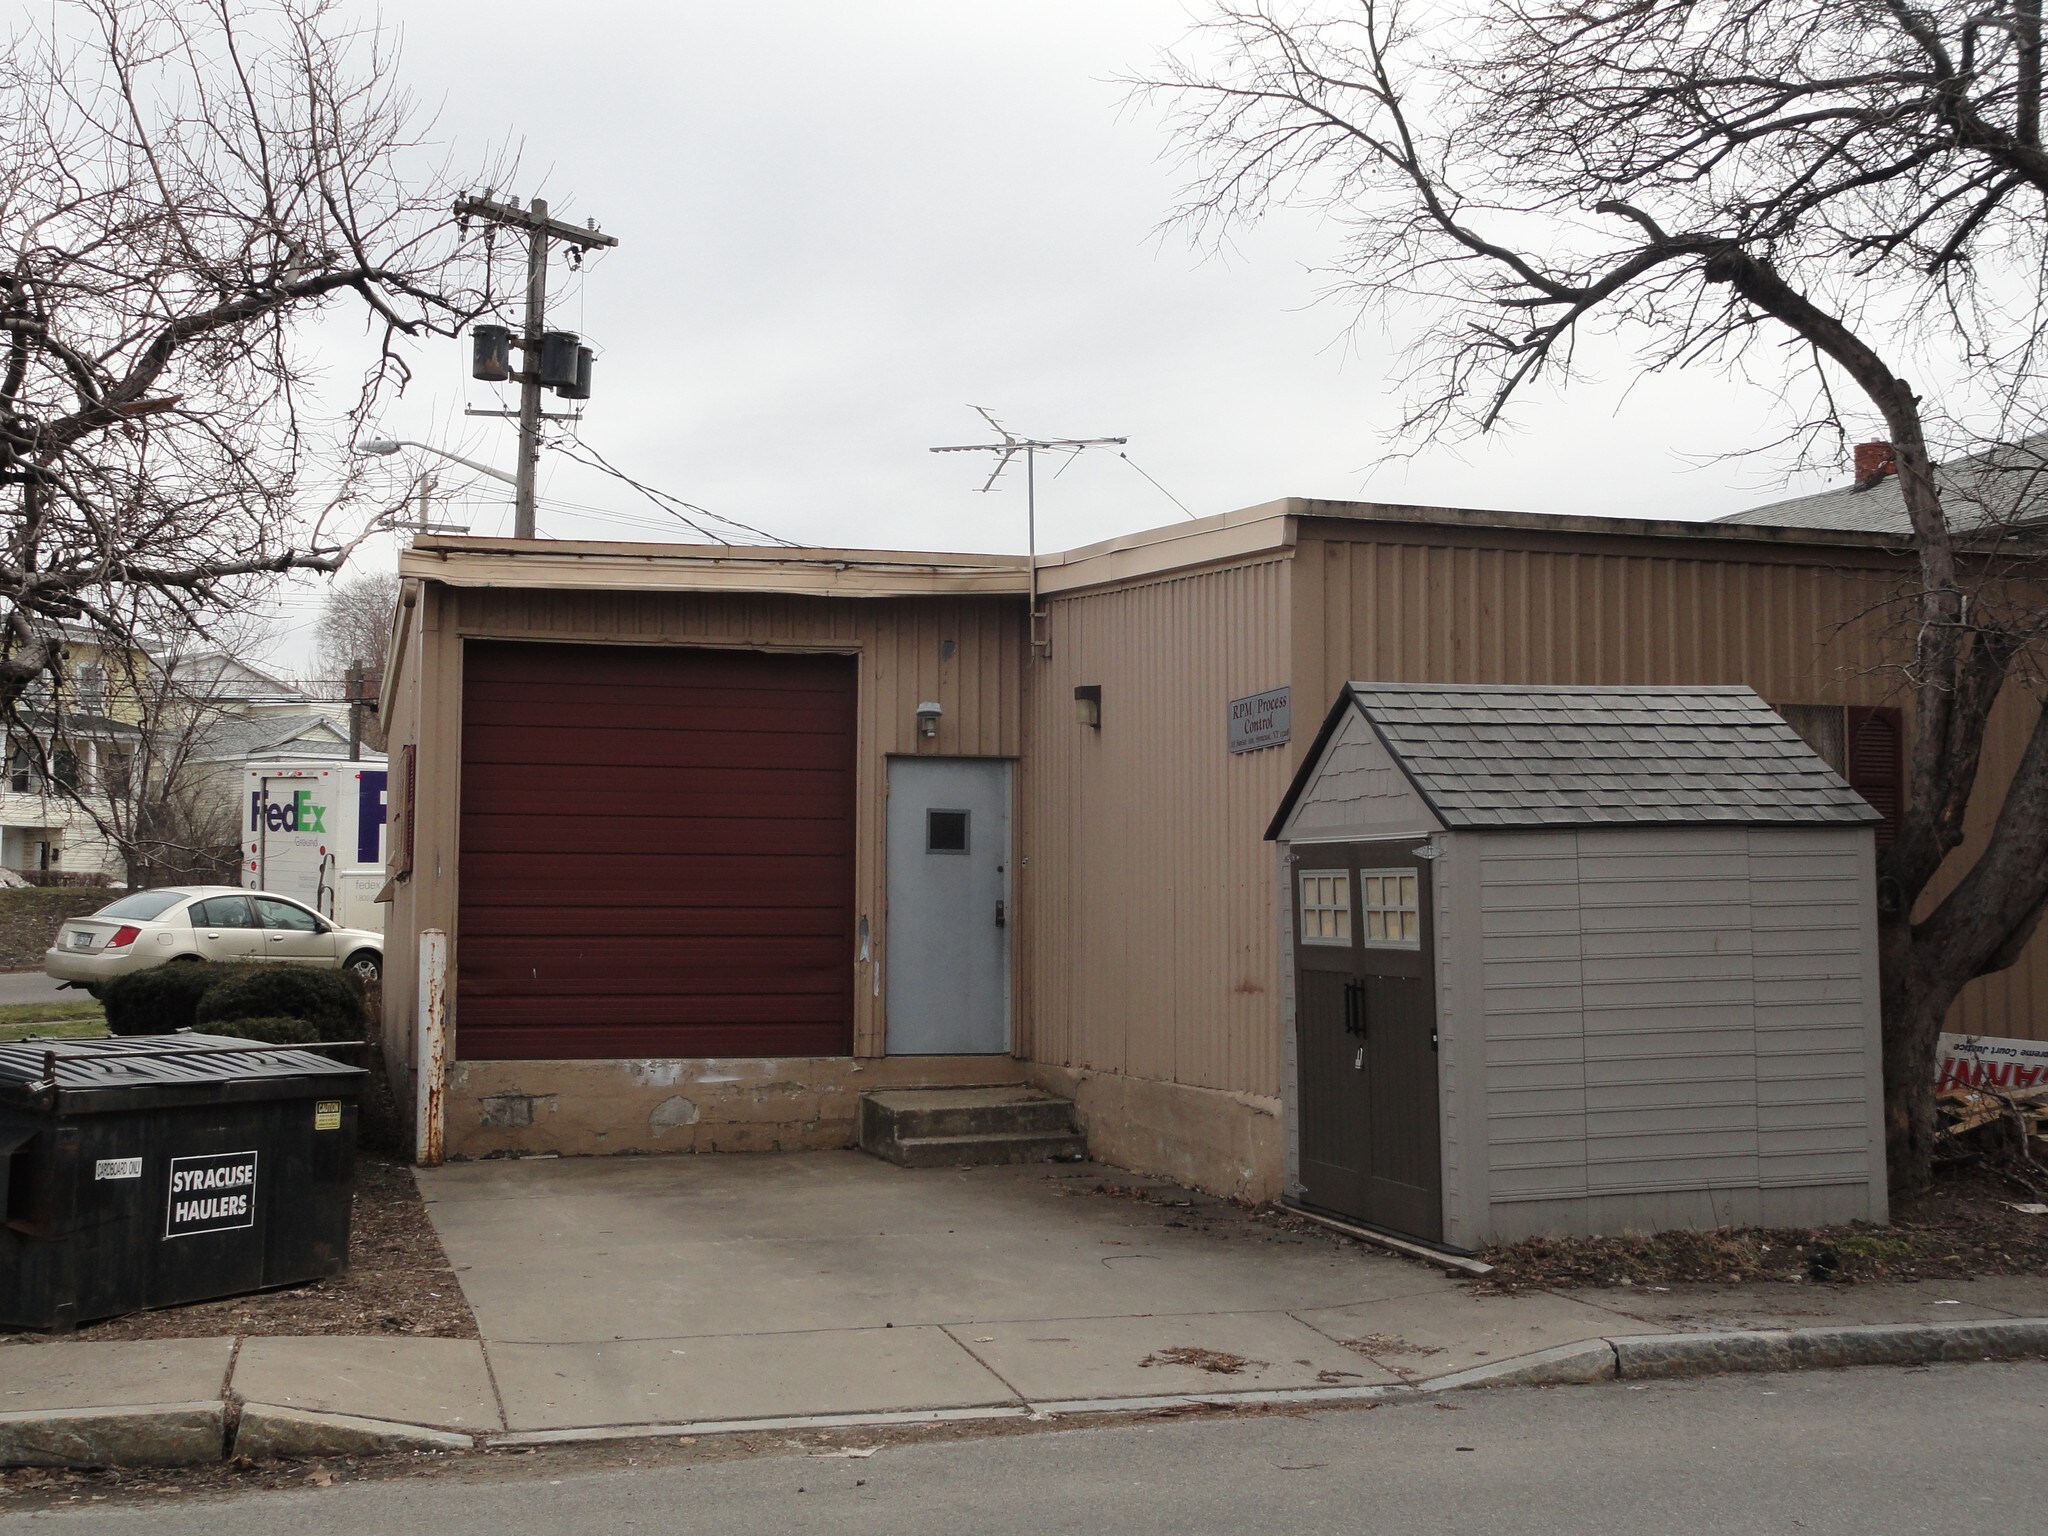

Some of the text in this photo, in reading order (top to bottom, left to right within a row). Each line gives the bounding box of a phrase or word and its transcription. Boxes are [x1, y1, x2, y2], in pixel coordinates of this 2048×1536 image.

[1257, 696, 1287, 714] Process
[1244, 711, 1274, 734] Control
[251, 790, 327, 833] FedEx
[294, 836, 318, 847] Ground
[1990, 1046, 2017, 1057] Court
[318, 1102, 339, 1113] CAUTION
[97, 1160, 141, 1177] CARDBOARD ONLY
[173, 1165, 253, 1192] SYRACUSE
[175, 1194, 247, 1223] HAULERS
